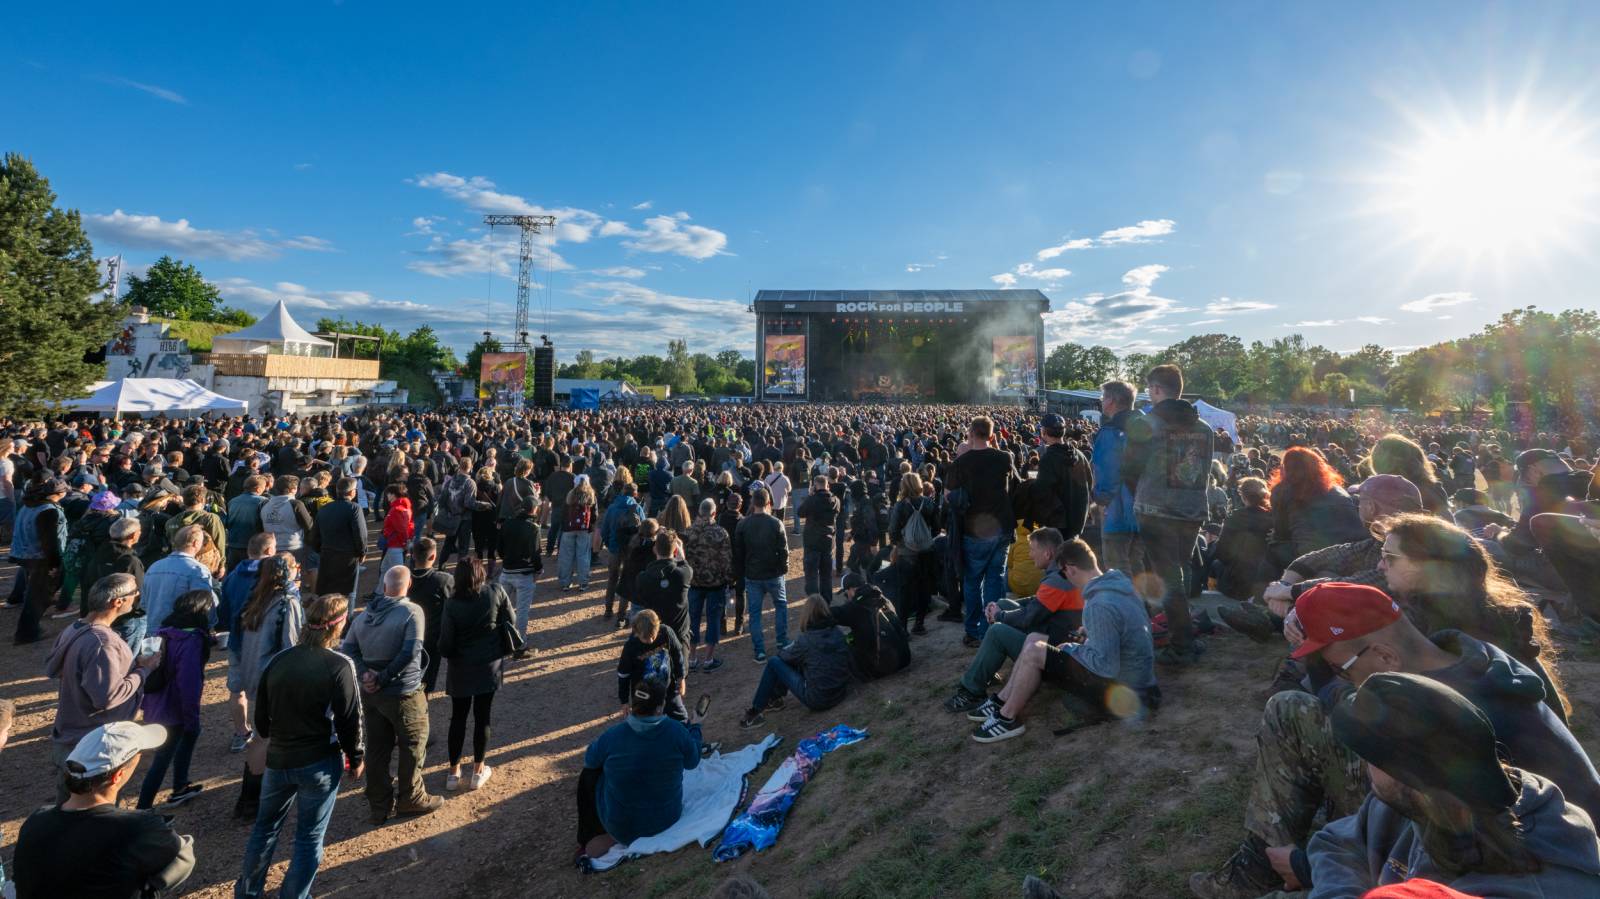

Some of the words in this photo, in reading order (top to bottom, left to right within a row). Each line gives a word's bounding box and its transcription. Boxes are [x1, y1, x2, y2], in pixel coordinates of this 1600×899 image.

[836, 302, 878, 312] ROCK
[879, 304, 901, 312] FOR
[903, 302, 964, 312] PEOPLE
